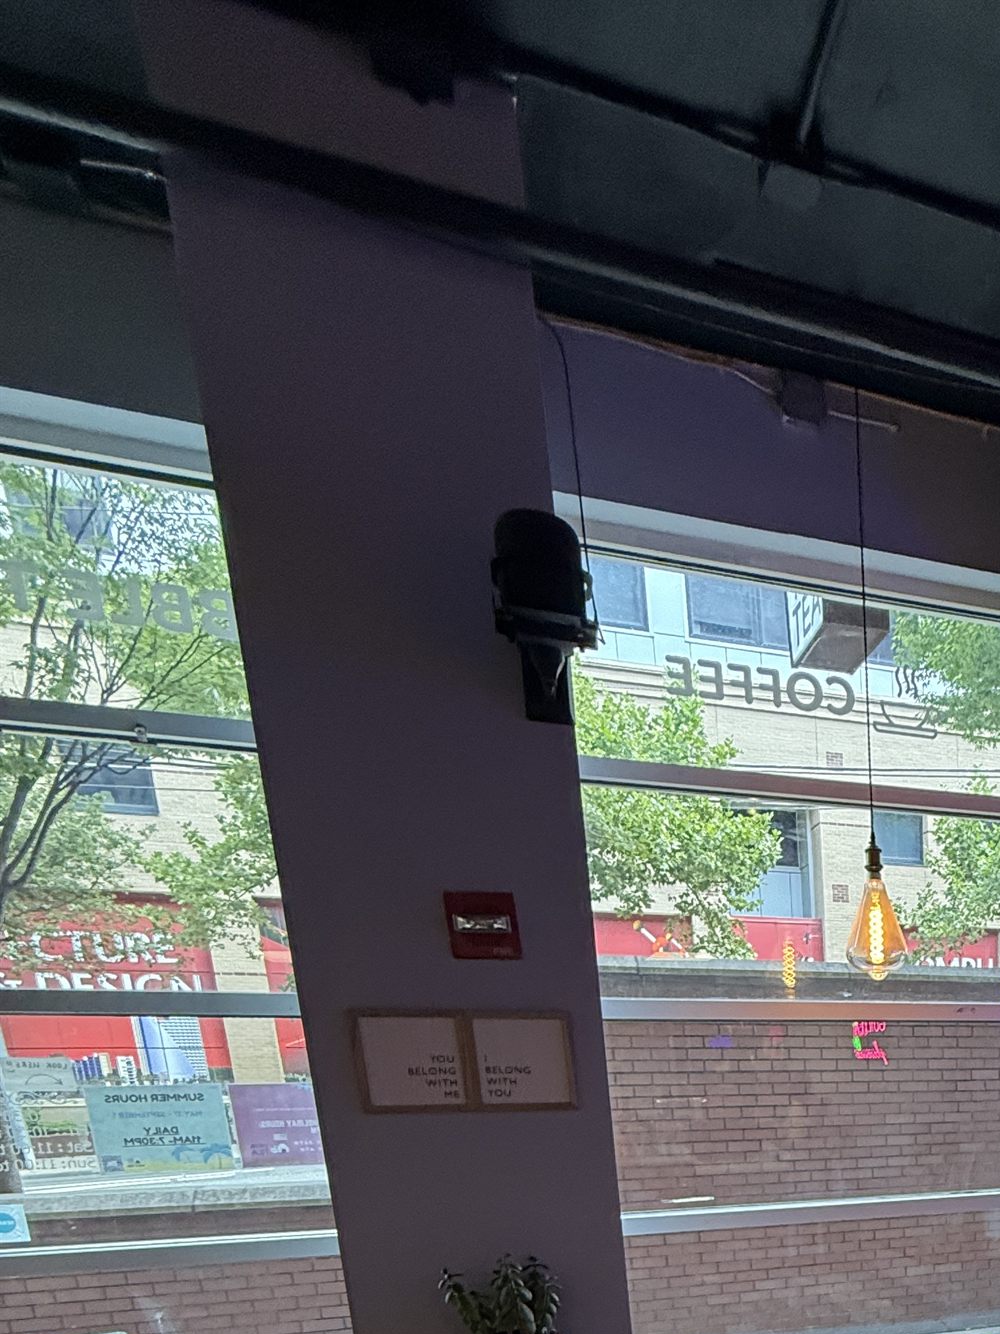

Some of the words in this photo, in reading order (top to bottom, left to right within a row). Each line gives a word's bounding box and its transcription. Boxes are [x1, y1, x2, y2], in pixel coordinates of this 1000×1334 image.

[430, 1054, 455, 1063] YOU
[407, 1066, 457, 1077] BELONG
[484, 1065, 532, 1075] BELONG
[425, 1079, 458, 1088] WITH
[486, 1077, 518, 1087] WITH
[443, 1090, 461, 1099] ME
[488, 1088, 512, 1098] YOU
